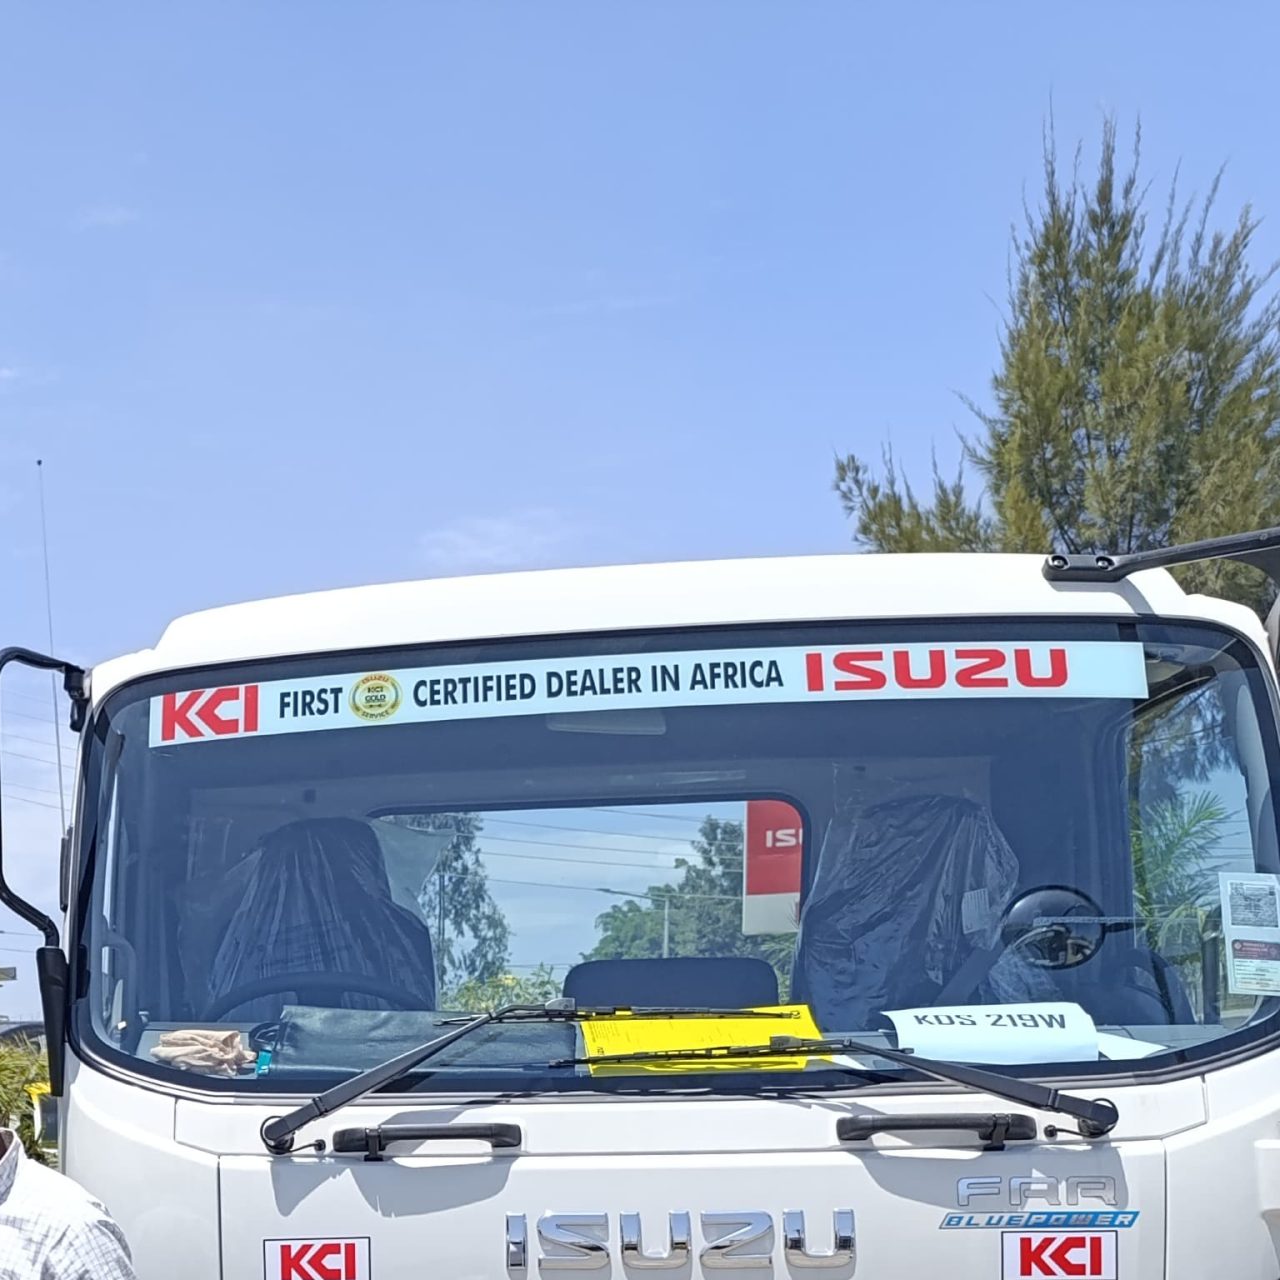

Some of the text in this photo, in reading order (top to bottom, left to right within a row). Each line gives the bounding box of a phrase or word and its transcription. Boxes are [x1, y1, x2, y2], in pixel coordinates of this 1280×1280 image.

[161, 648, 1068, 741] KCI FIRST CERTIFIED DEALER IN AFRICA ISUZU
[765, 828, 803, 848] IS
[913, 1013, 1066, 1029] KDS 219W
[505, 1209, 856, 1270] ISUZU
[1020, 1237, 1102, 1276] KCI
[280, 1243, 356, 1280] KCI
